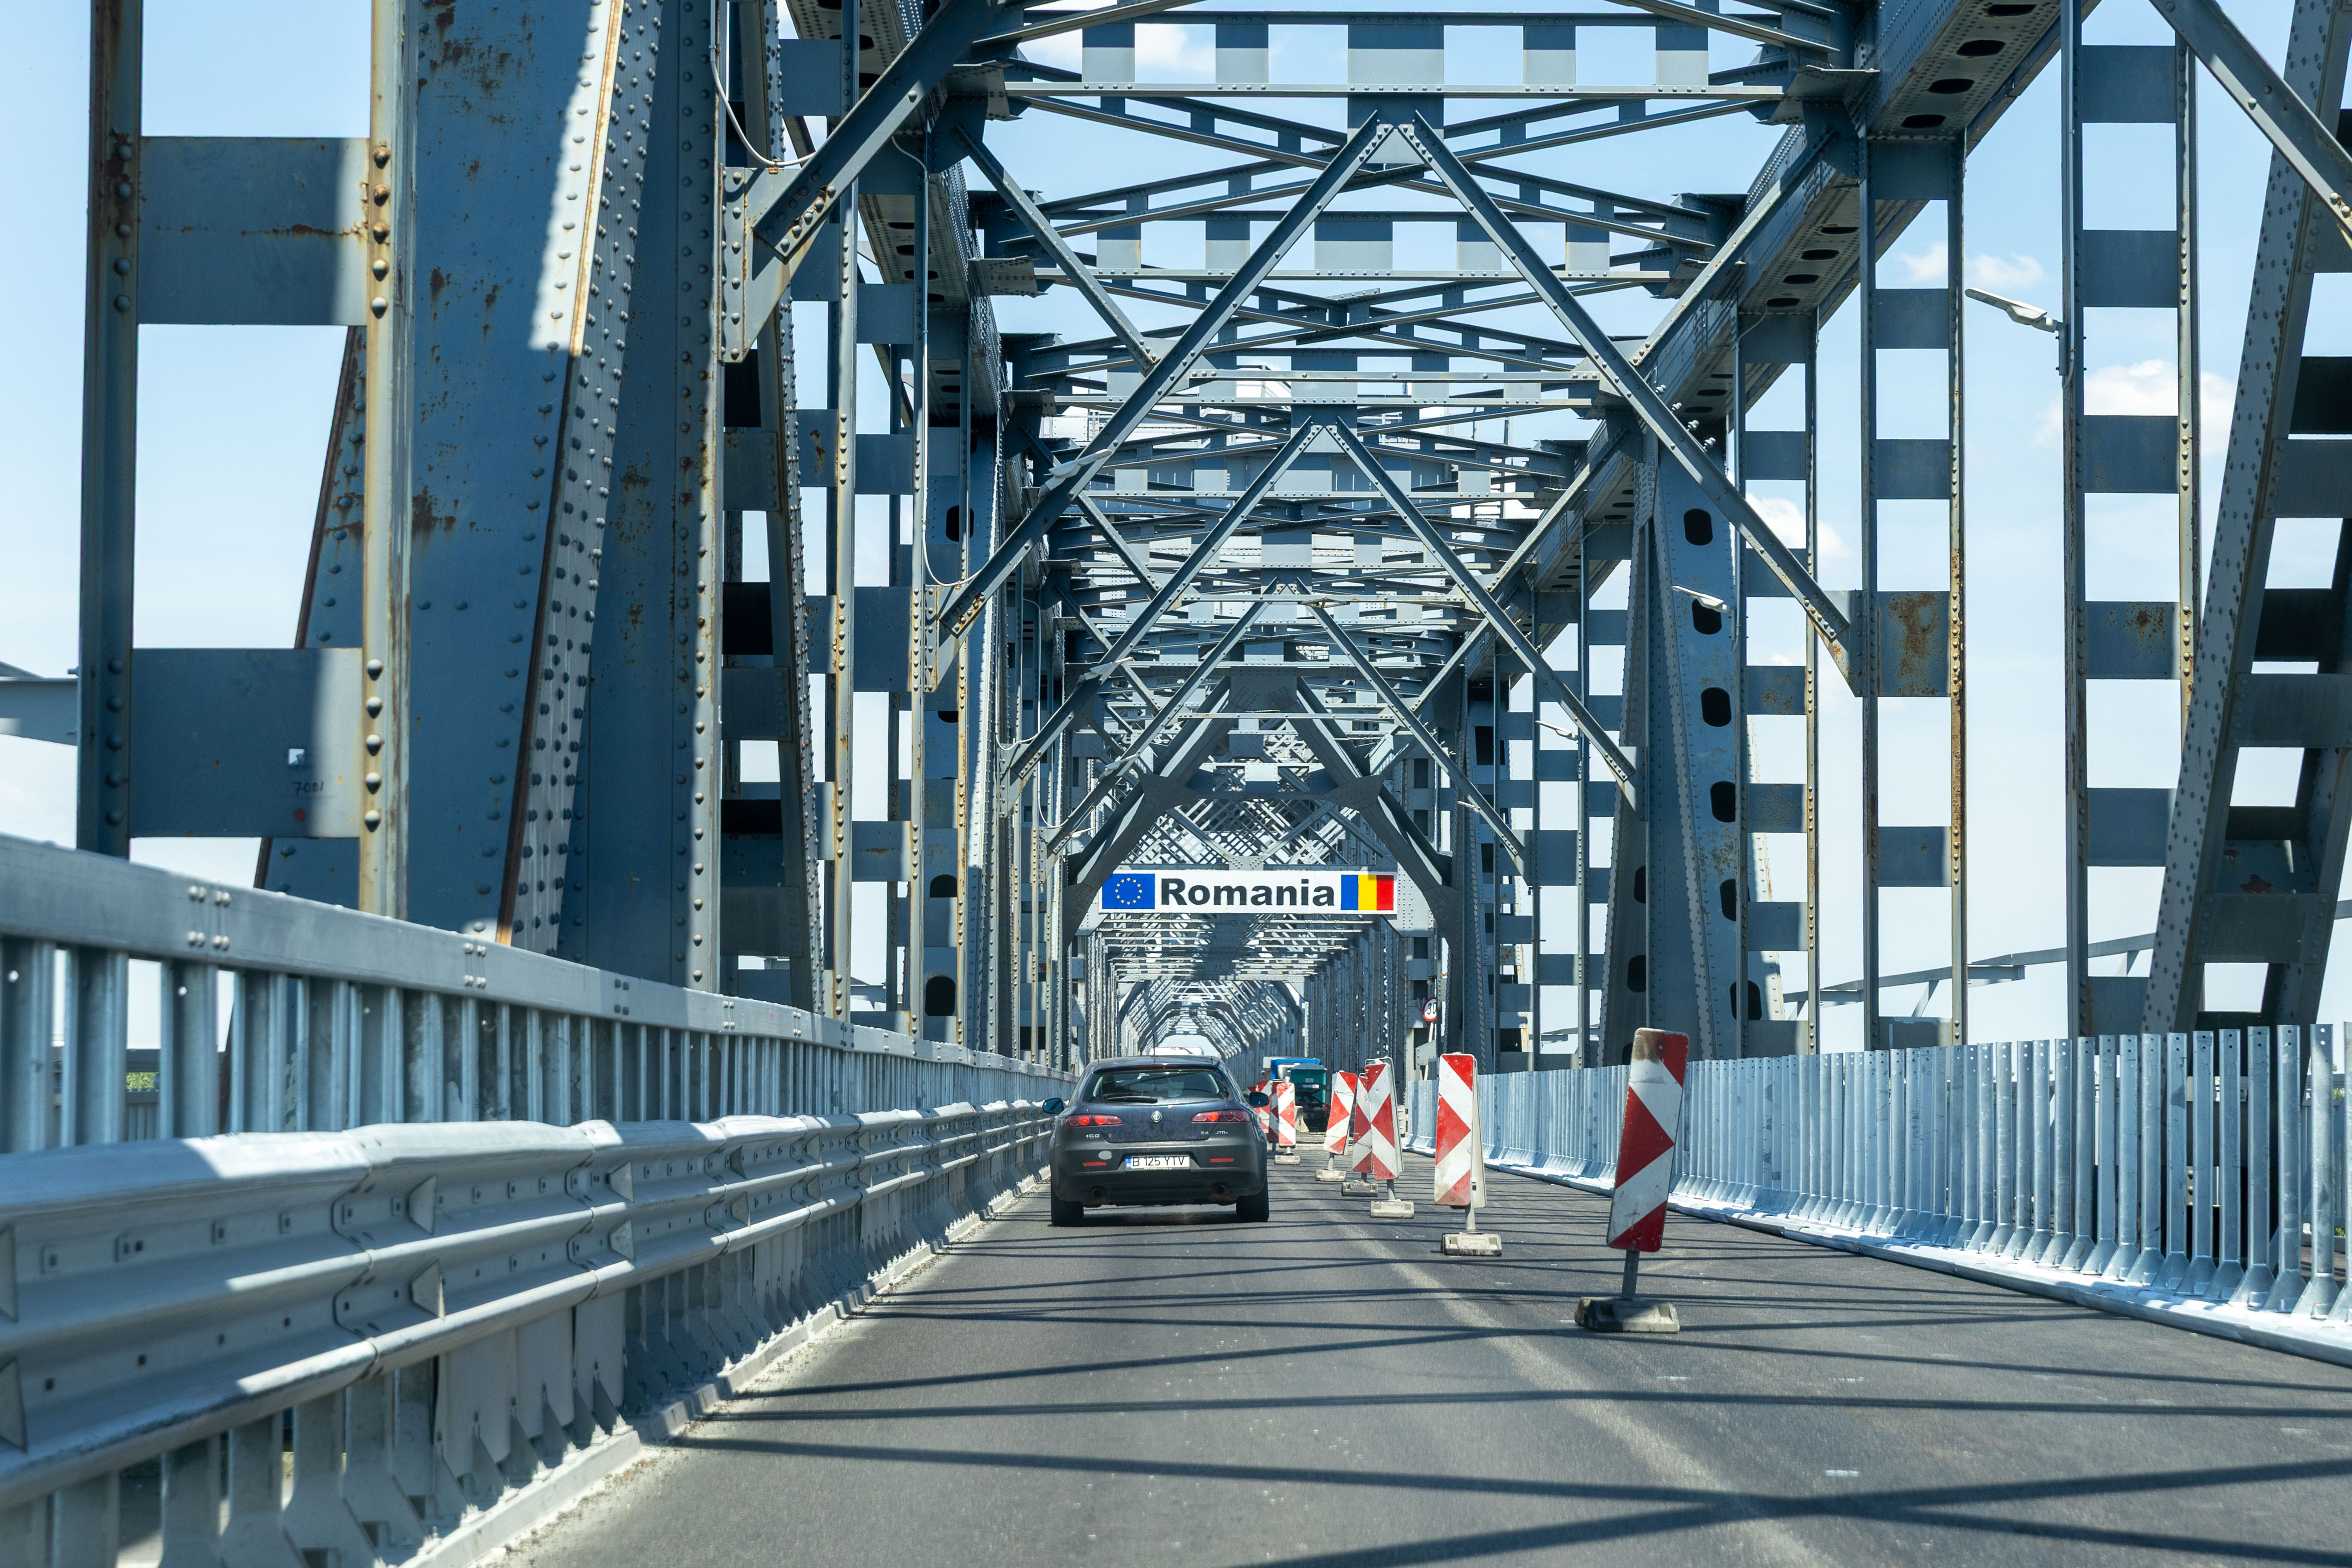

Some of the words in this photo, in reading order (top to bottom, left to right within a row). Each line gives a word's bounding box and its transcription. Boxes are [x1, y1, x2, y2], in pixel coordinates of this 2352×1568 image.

[1161, 878, 1334, 906] Romania
[1427, 1002, 1437, 1015] 30
[1133, 1157, 1140, 1166] B
[1144, 1156, 1160, 1166] 125
[1164, 1156, 1185, 1166] YTV
